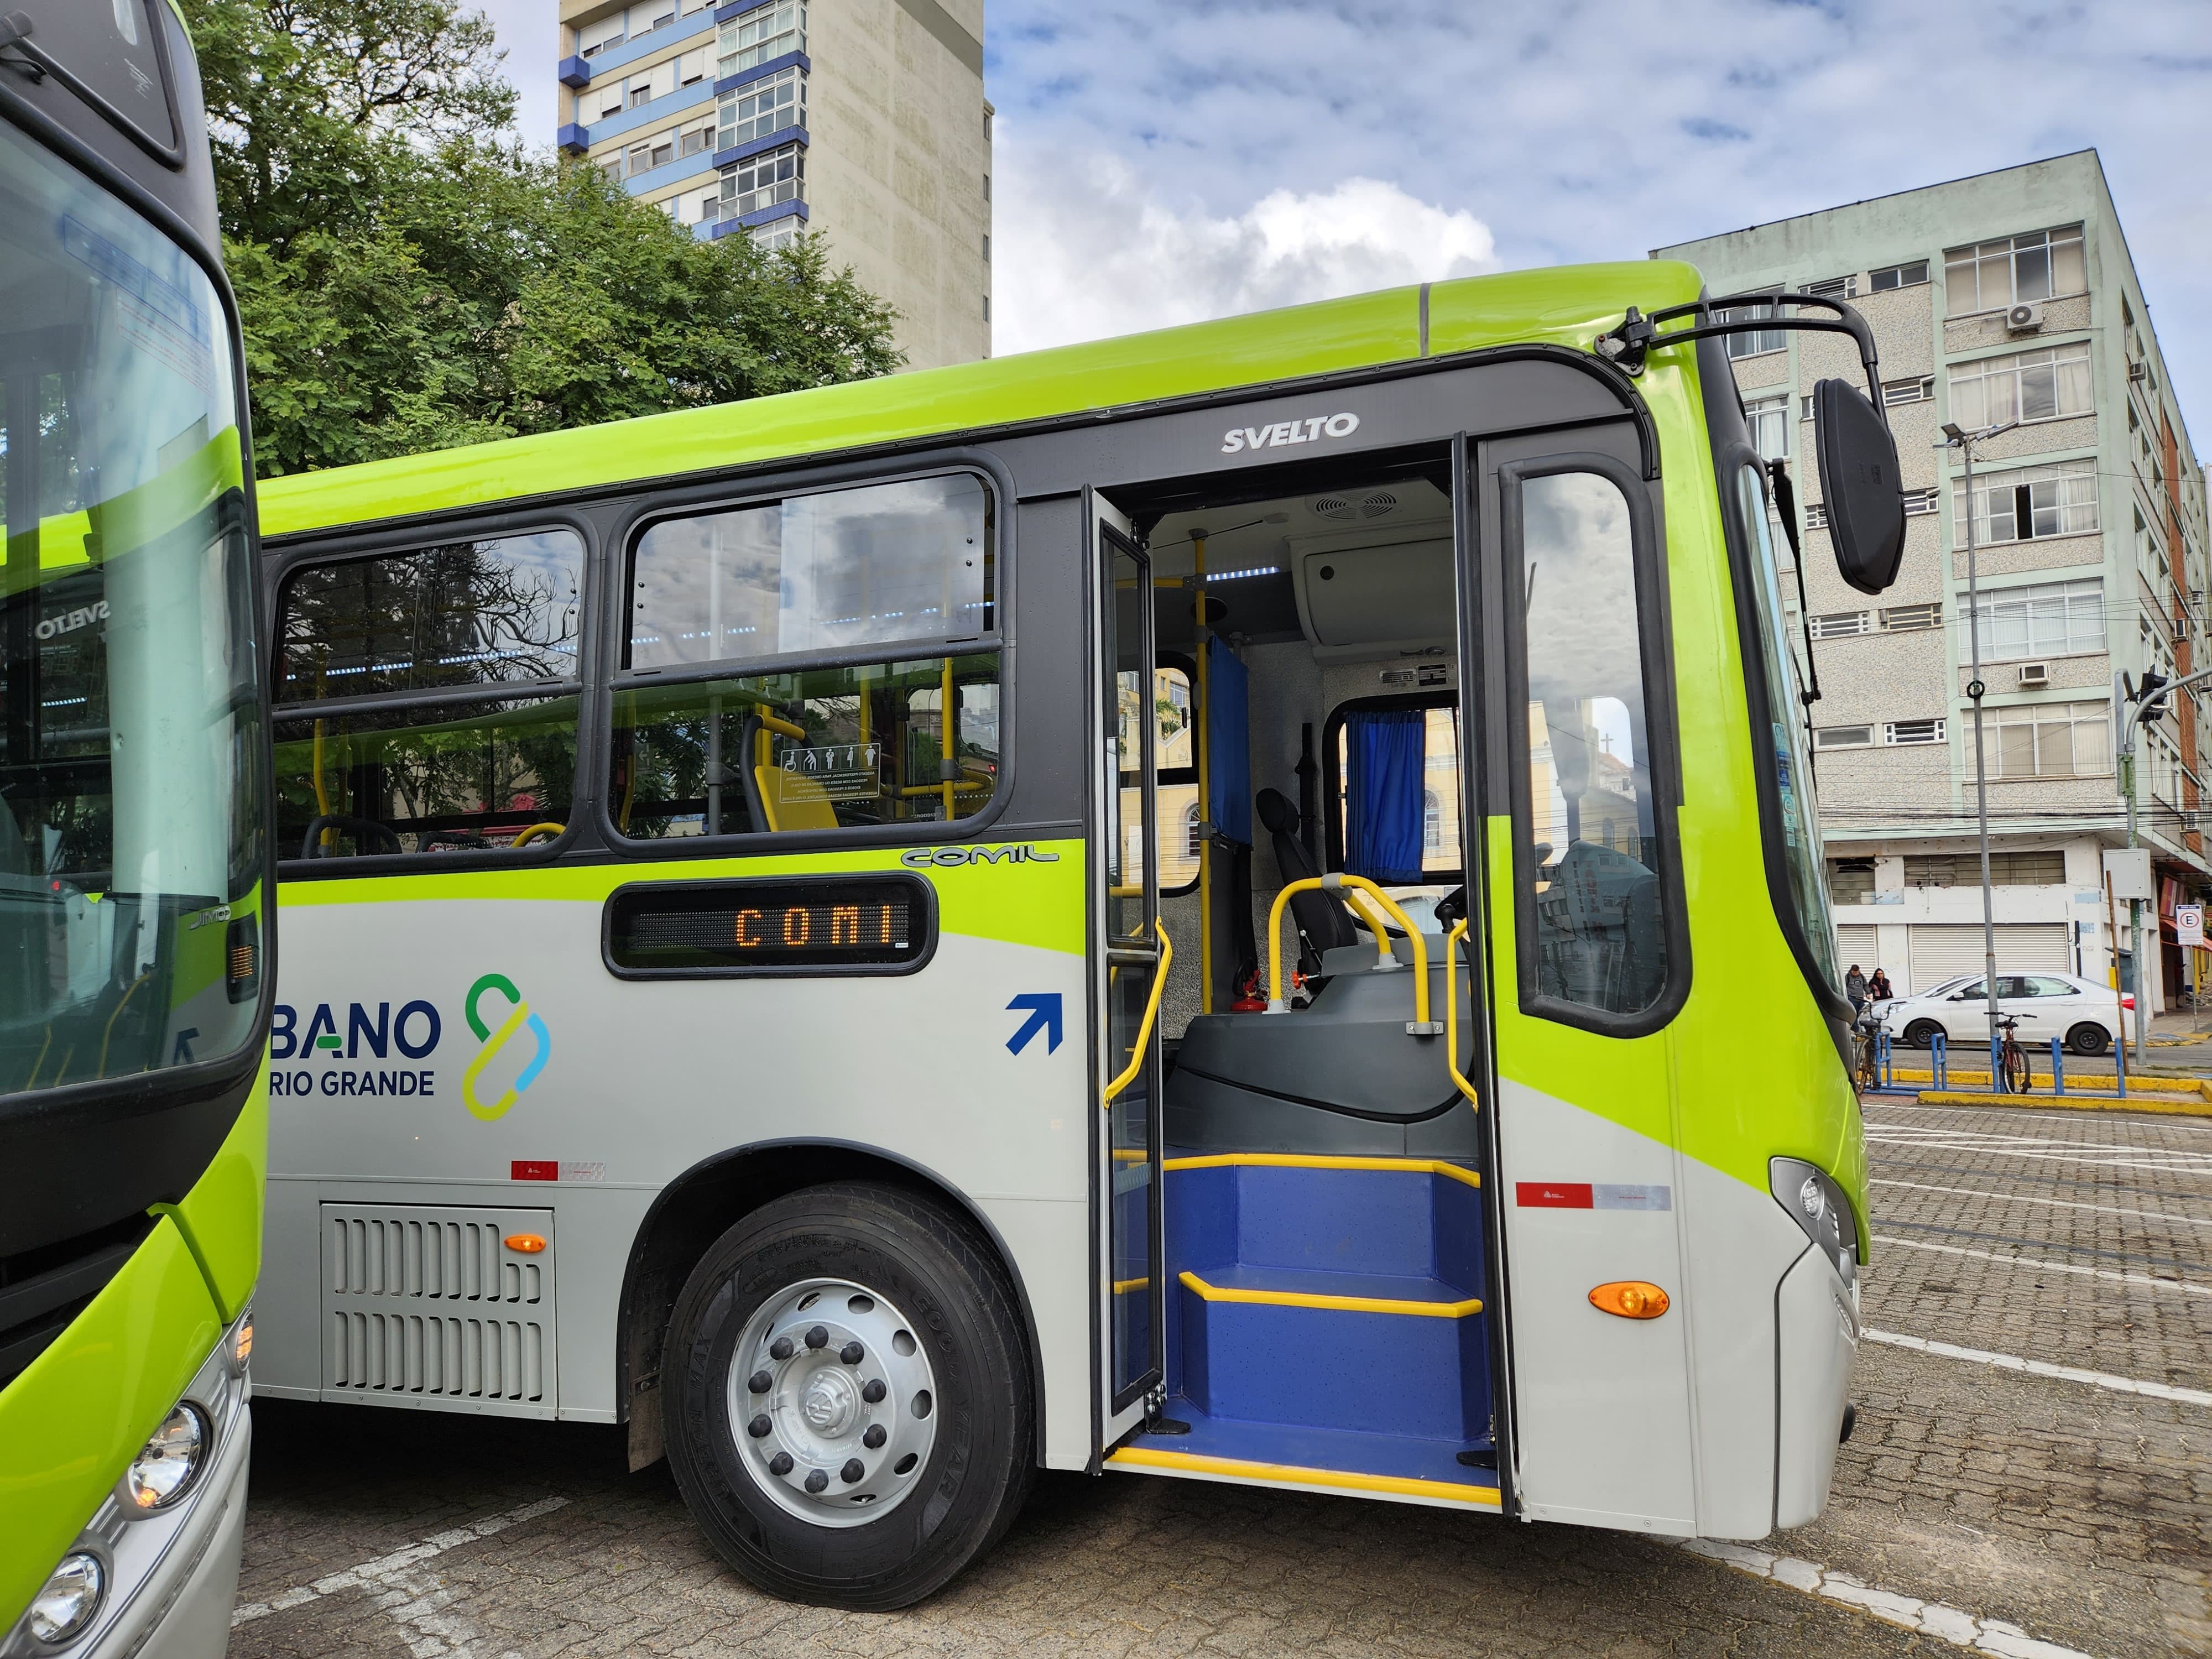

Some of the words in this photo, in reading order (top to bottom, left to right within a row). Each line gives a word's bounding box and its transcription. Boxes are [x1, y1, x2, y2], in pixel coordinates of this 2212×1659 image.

[1220, 411, 1360, 454] SVELTO
[900, 844, 1059, 868] COMIL
[2186, 915, 2193, 925] E
[269, 1071, 312, 1096] RIO
[320, 1071, 435, 1096] GRANDE
